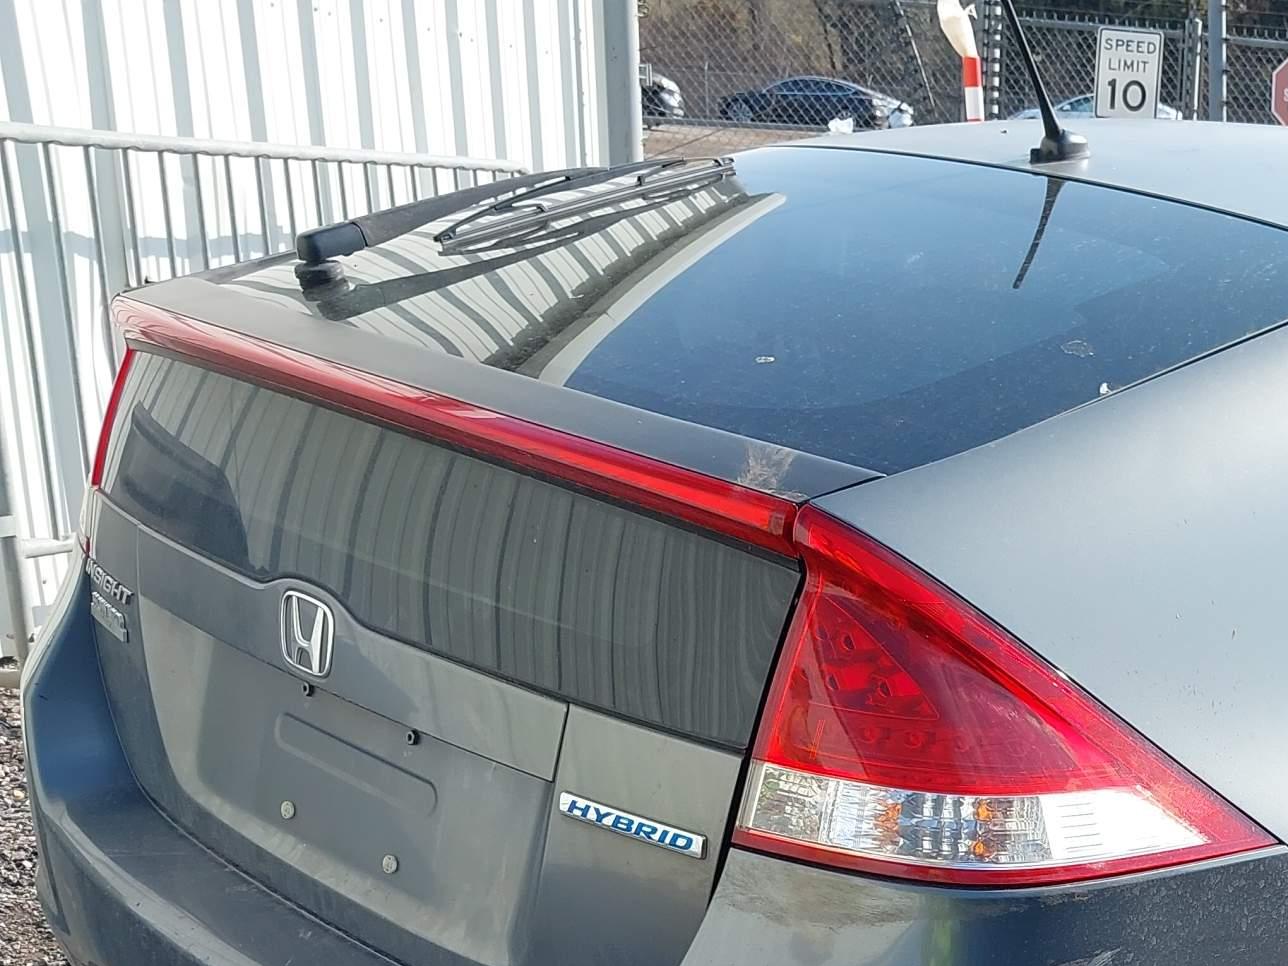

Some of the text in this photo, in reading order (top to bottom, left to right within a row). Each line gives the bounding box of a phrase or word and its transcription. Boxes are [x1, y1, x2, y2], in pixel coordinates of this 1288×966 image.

[1104, 38, 1157, 54] SPEED
[1108, 58, 1149, 73] LIMIT
[1107, 78, 1147, 112] 10
[567, 799, 694, 851] HYBRID
